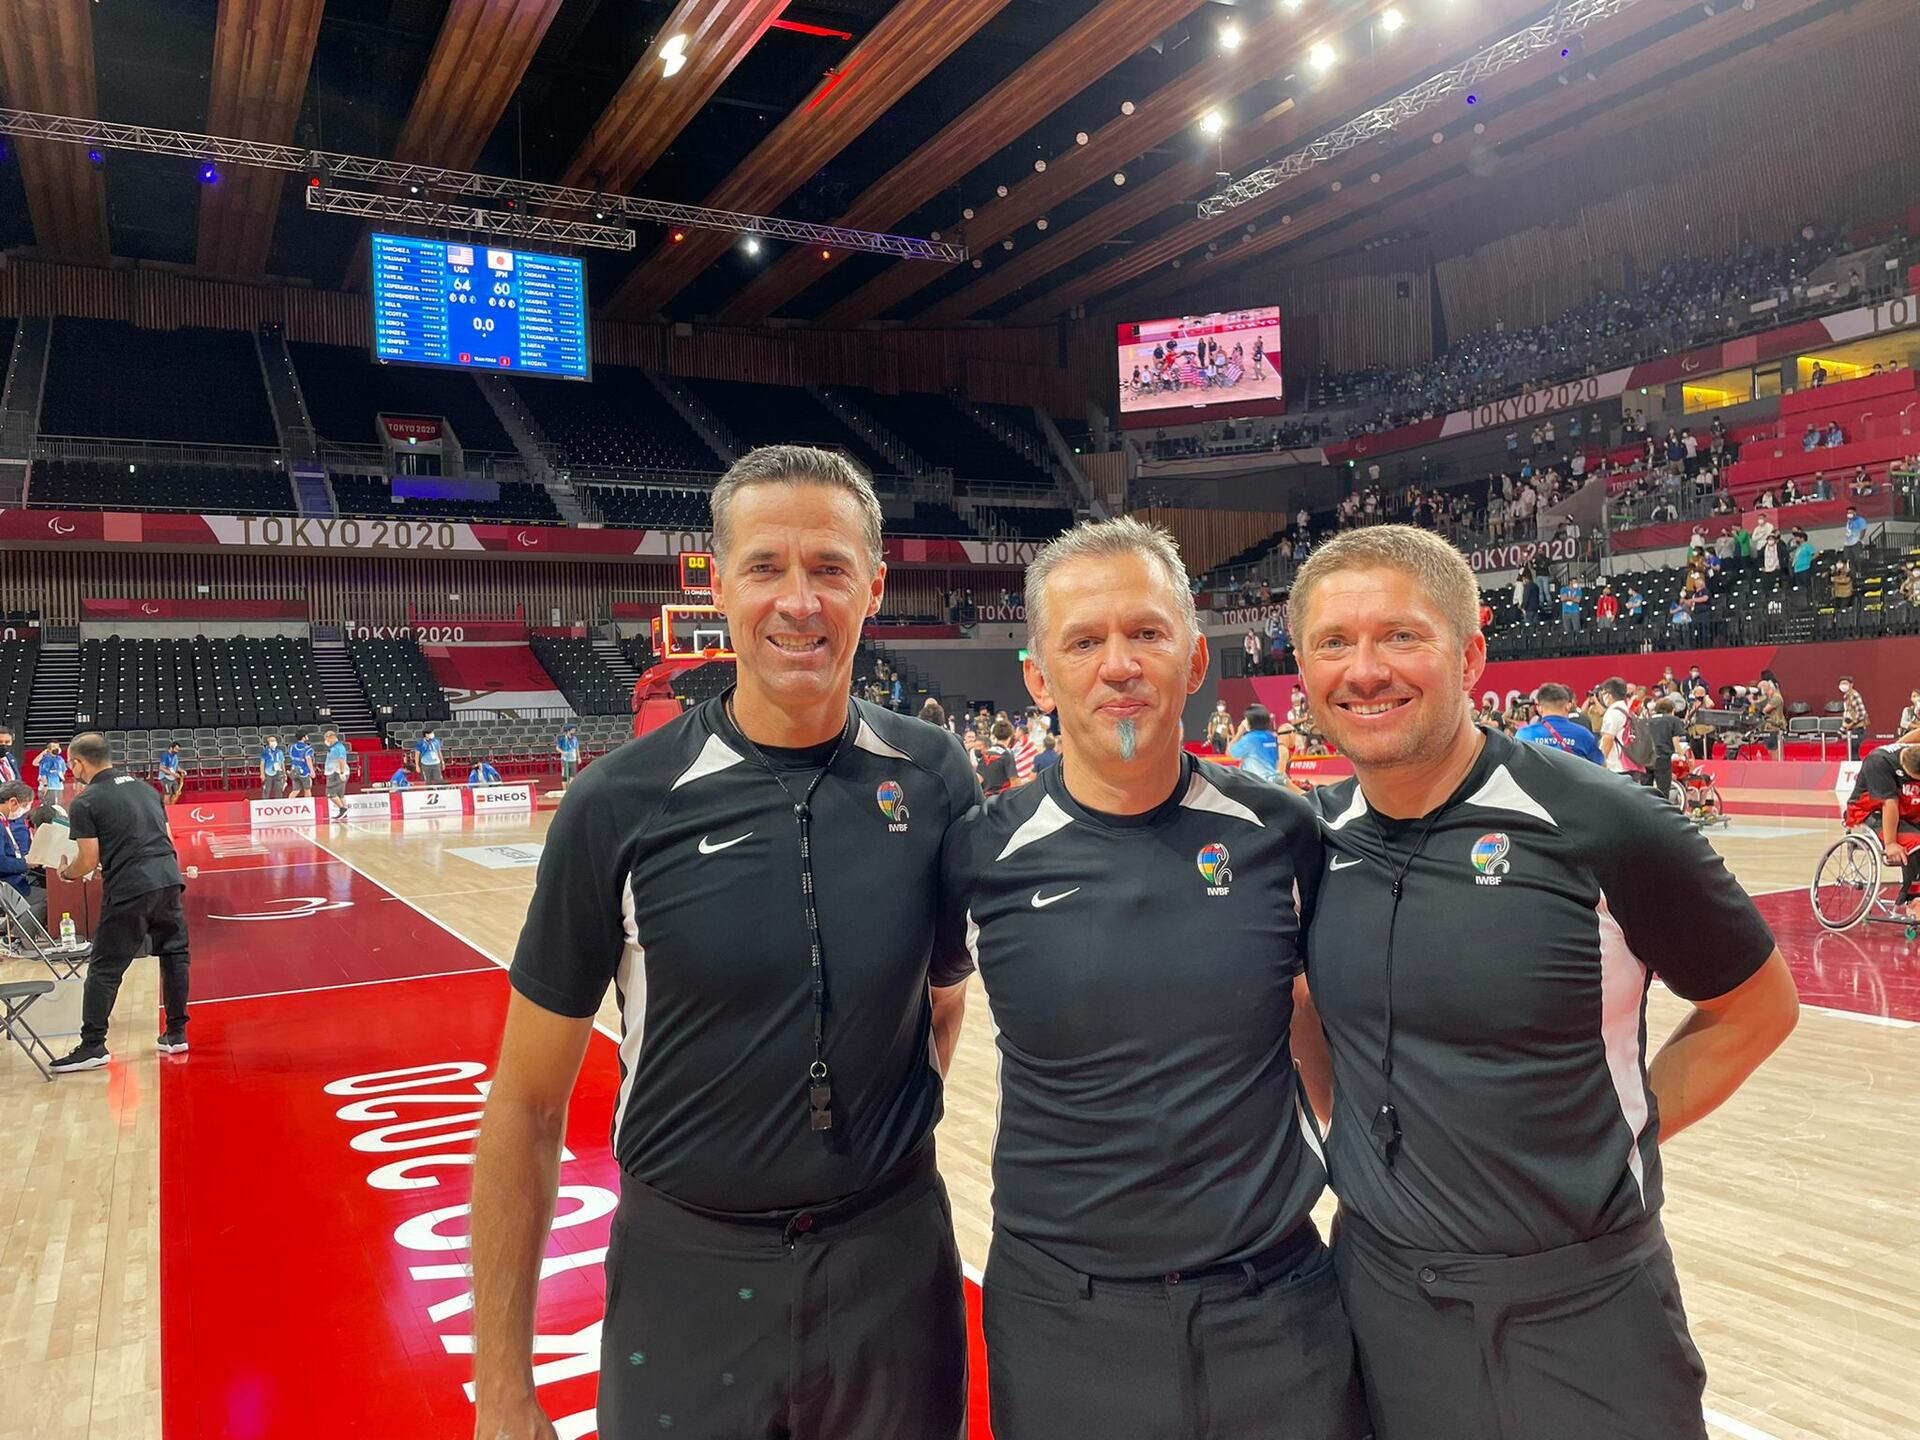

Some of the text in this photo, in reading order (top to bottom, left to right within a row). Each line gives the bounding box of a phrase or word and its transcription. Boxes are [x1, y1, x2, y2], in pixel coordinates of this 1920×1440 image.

[453, 265, 470, 274] USA
[495, 271, 508, 279] JPN
[453, 278, 471, 291] 64
[493, 282, 510, 296] 60
[1867, 296, 1920, 336] TO
[473, 317, 495, 332] 0.0
[1226, 318, 1278, 331] TOKYO
[1468, 377, 1599, 431] TOKYO 2020
[388, 423, 436, 433] TOKYO 2020
[236, 516, 454, 549] TOKYO 2020
[981, 541, 1046, 566] TOKY
[1462, 545, 1521, 571] OKYO
[976, 605, 1025, 620] TOKYO
[1222, 607, 1258, 626] TOKYO
[345, 626, 464, 642] TOKYO 2020
[1535, 737, 1558, 745] TOKYO
[487, 792, 527, 803] ENEOS
[255, 805, 311, 817] TOYOTA
[888, 823, 908, 832] IWBF
[1475, 875, 1502, 885] IWBF
[1207, 887, 1230, 896] IWBF
